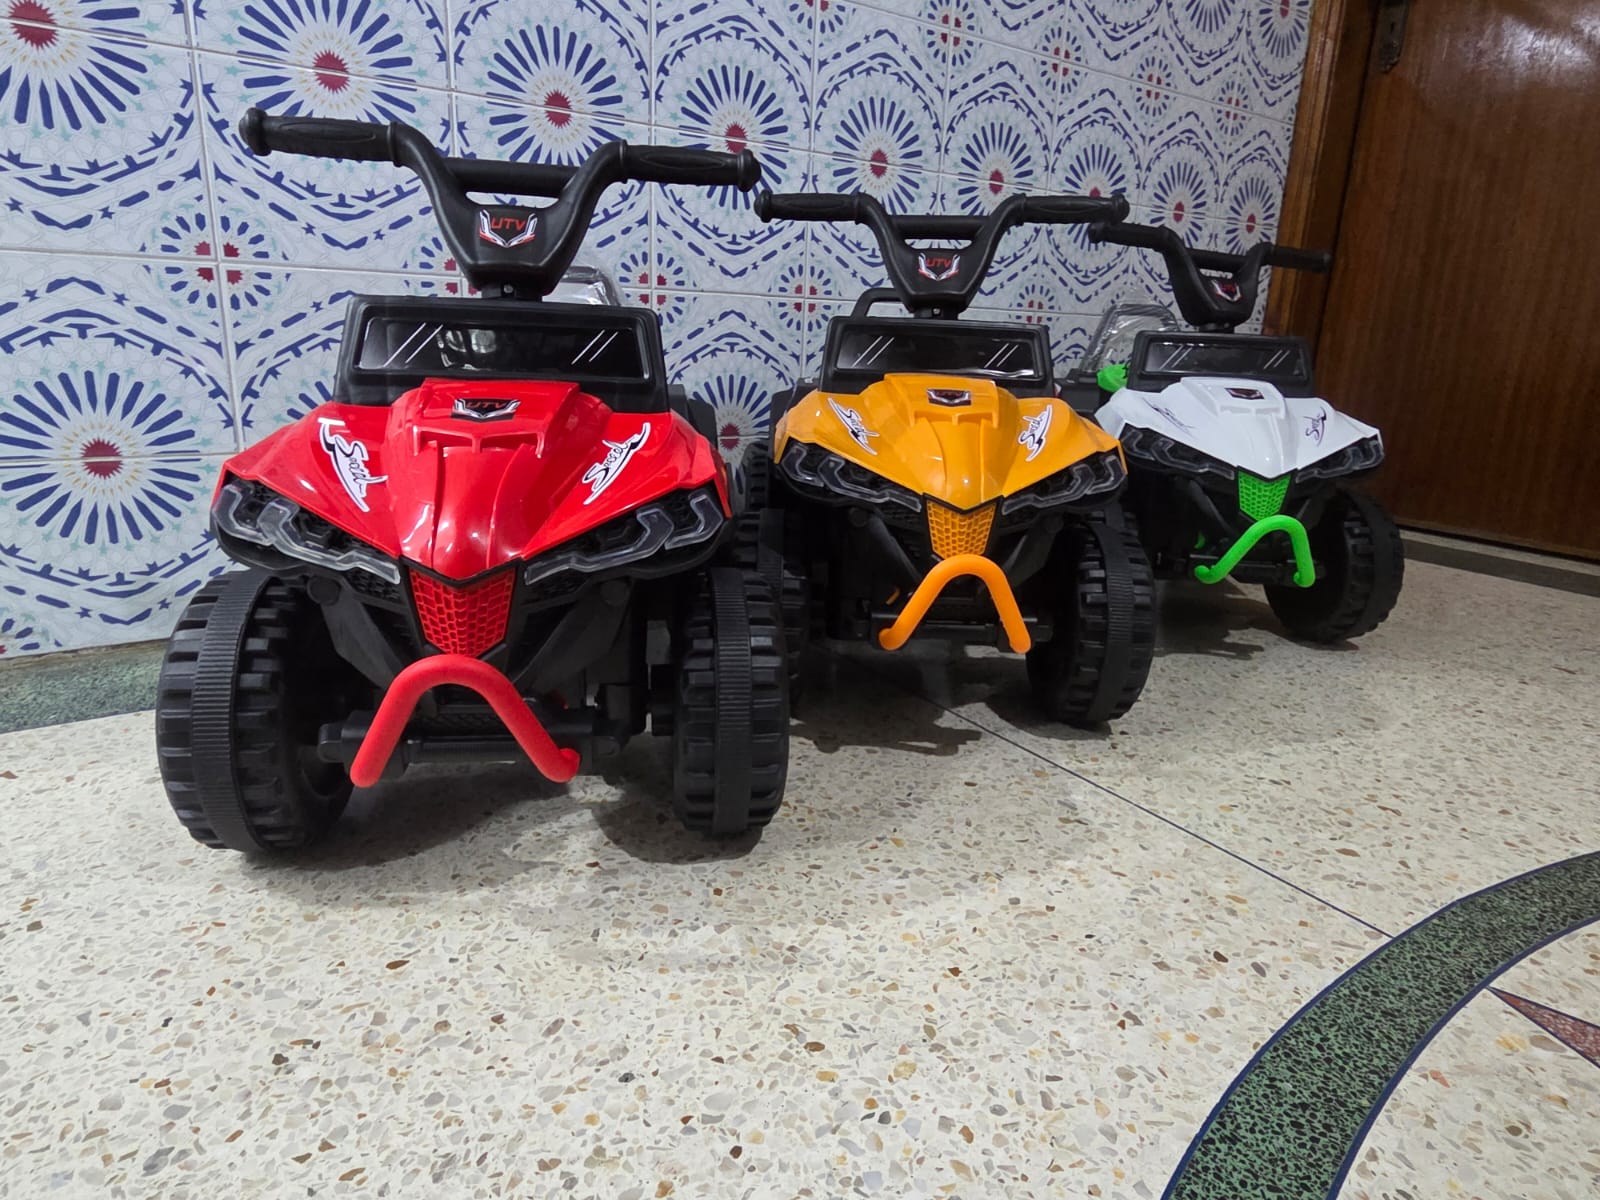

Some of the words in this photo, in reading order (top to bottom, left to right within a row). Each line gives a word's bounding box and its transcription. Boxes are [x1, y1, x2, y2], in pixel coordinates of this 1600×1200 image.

[491, 216, 527, 232] UTV
[925, 257, 952, 268] UTV
[466, 401, 506, 409] UTV
